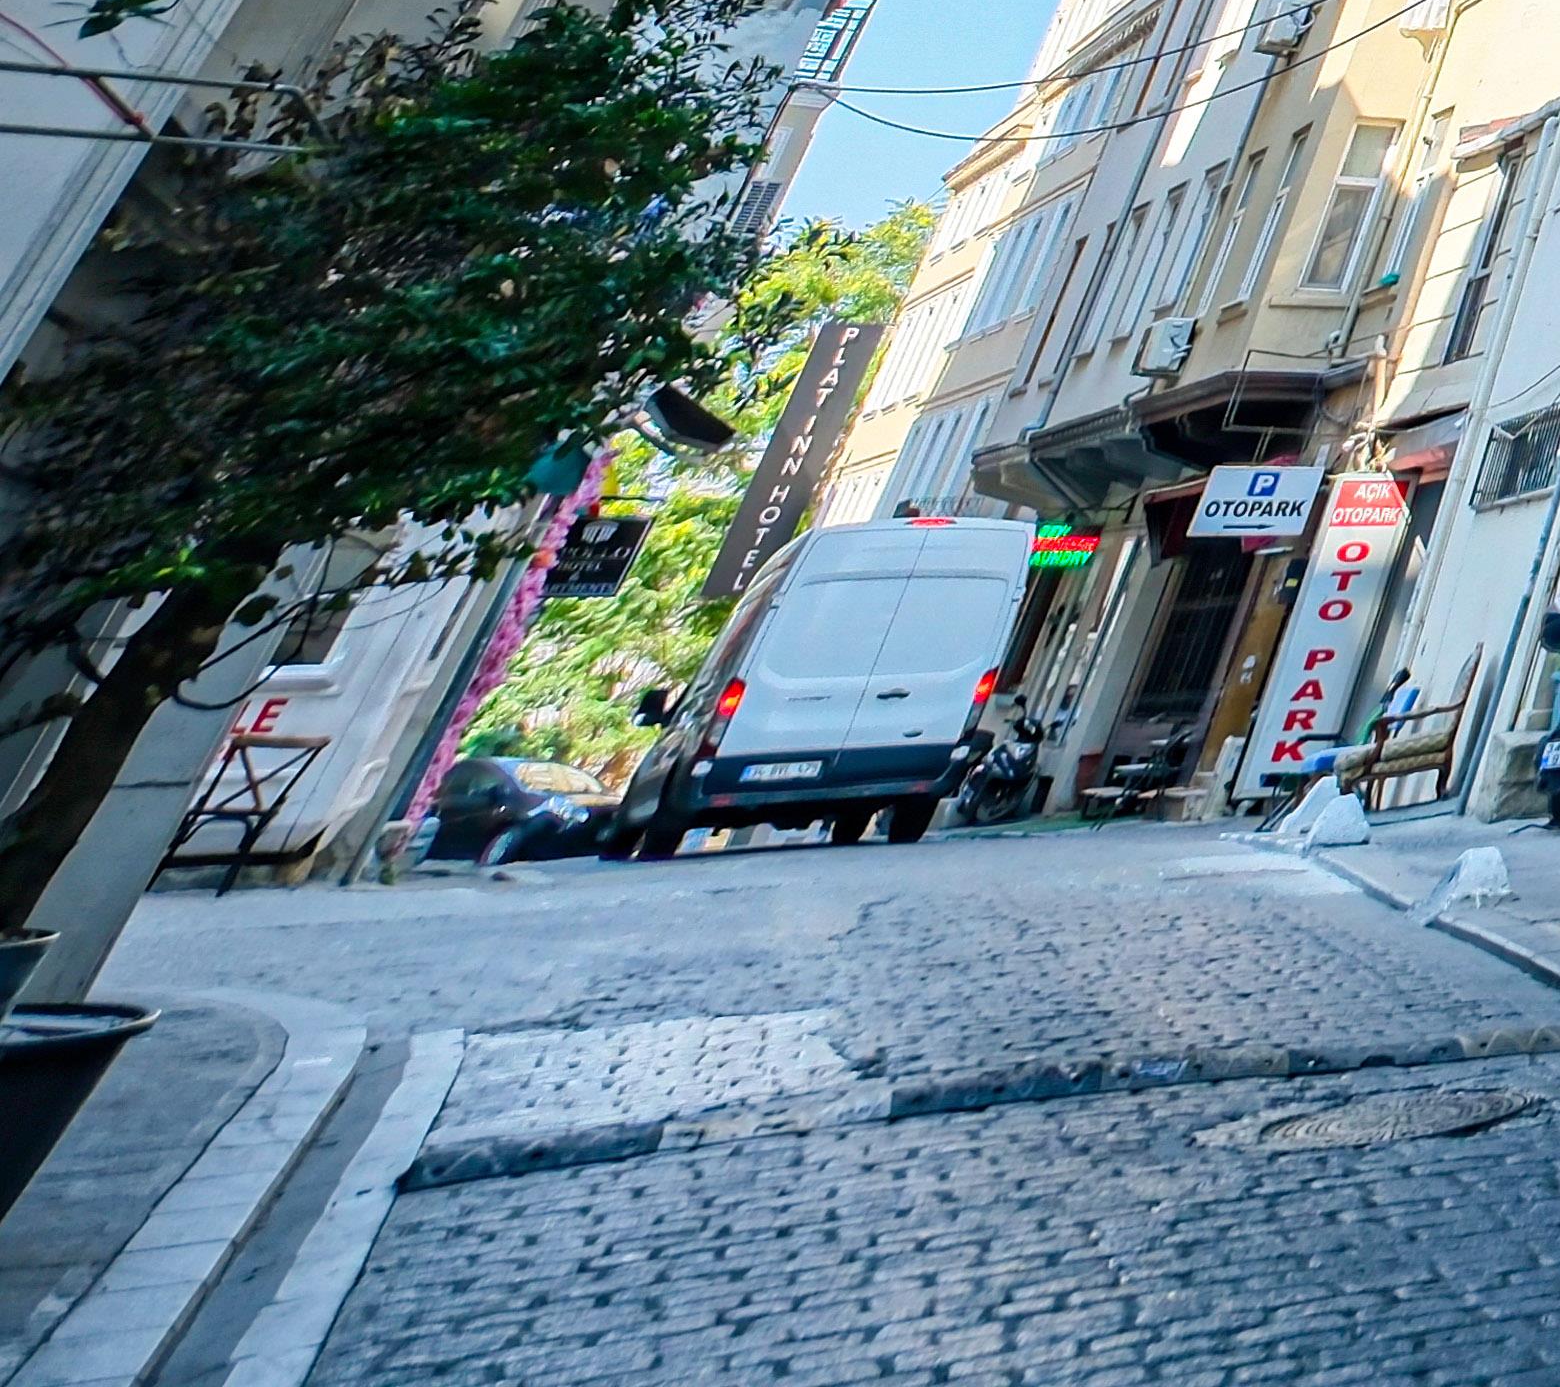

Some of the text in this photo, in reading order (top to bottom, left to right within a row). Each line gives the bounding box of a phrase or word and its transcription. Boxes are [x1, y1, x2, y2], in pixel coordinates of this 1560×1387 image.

[732, 326, 860, 591] PLAT INN HOTEL
[1355, 481, 1393, 503] AÇIK
[1204, 498, 1307, 519] OTOPARK
[1332, 506, 1404, 524] OTOPARK
[1271, 540, 1371, 763] OTO PARK
